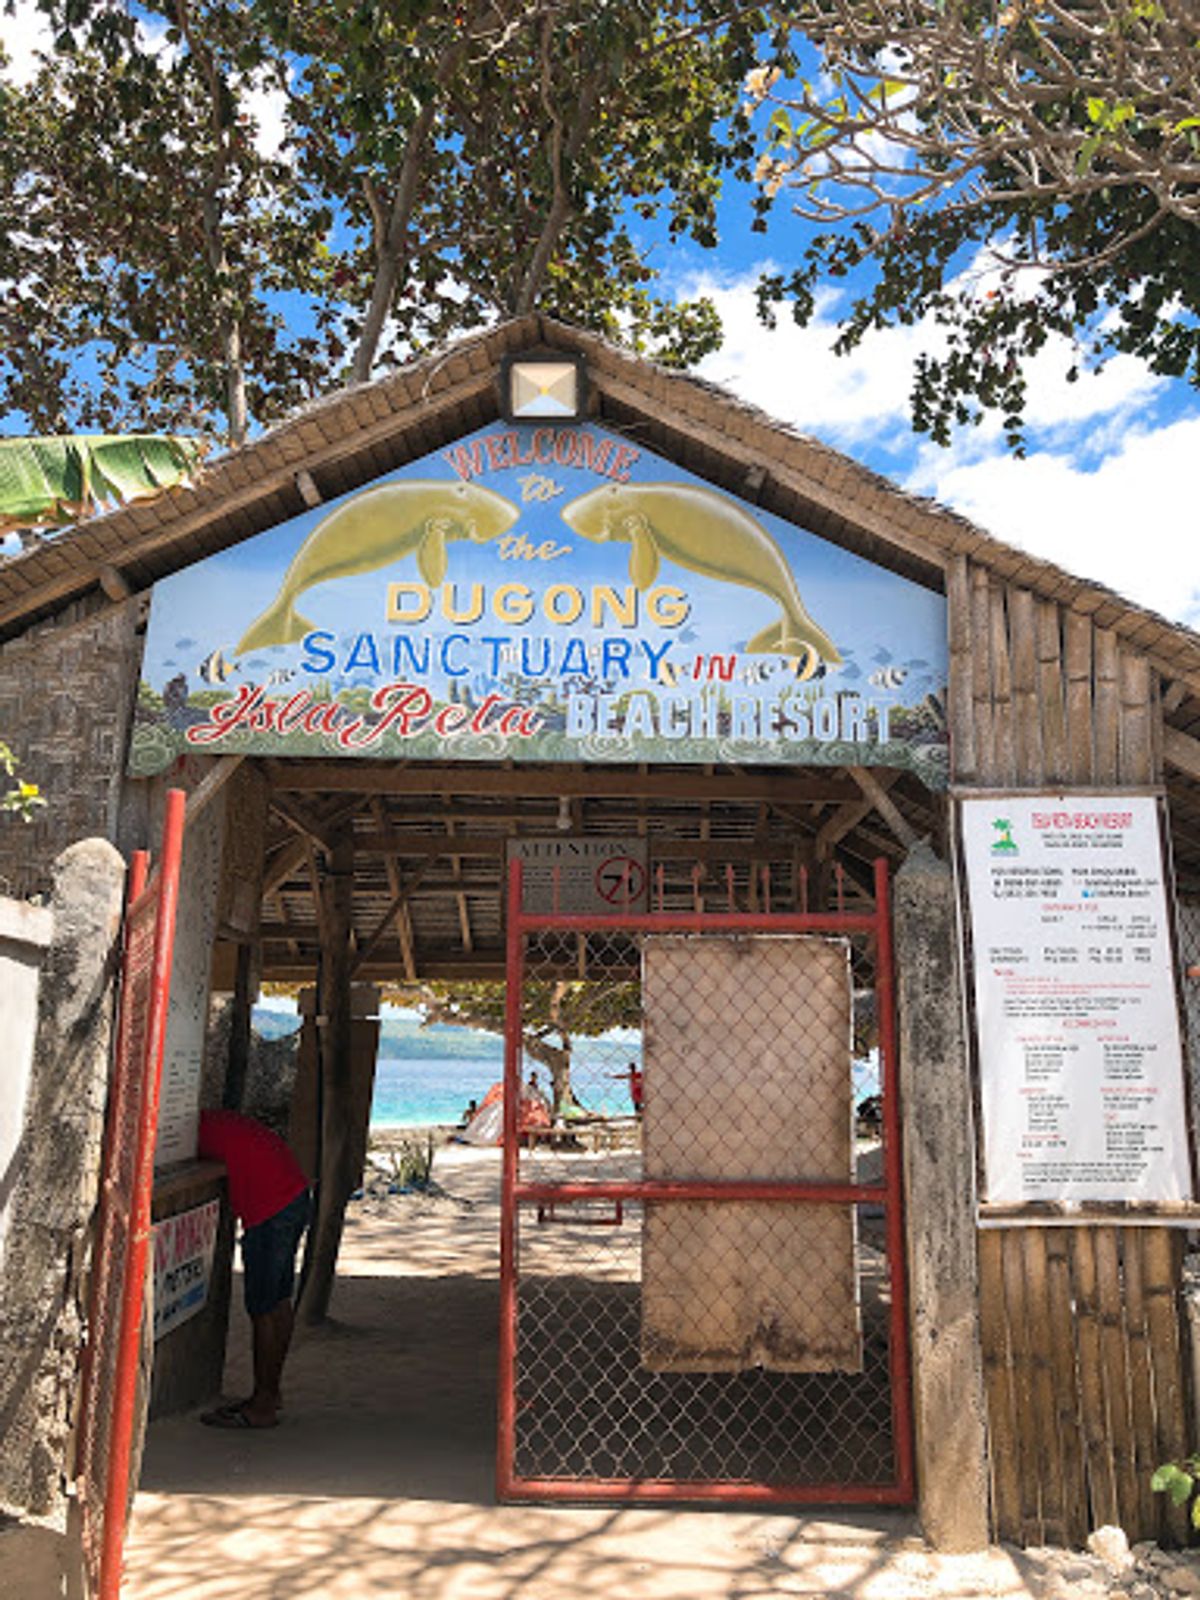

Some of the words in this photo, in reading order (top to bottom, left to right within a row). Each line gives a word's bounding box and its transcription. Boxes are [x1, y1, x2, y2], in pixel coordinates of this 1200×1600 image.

[443, 427, 641, 484] WELCOME
[516, 472, 564, 503] to
[496, 531, 574, 561] the
[386, 582, 692, 628] DUGONG
[300, 630, 674, 680] SANCTUARY
[693, 655, 737, 682] IN
[338, 681, 545, 749] Reta
[565, 692, 717, 740] BEACH
[729, 692, 898, 744] RESORT
